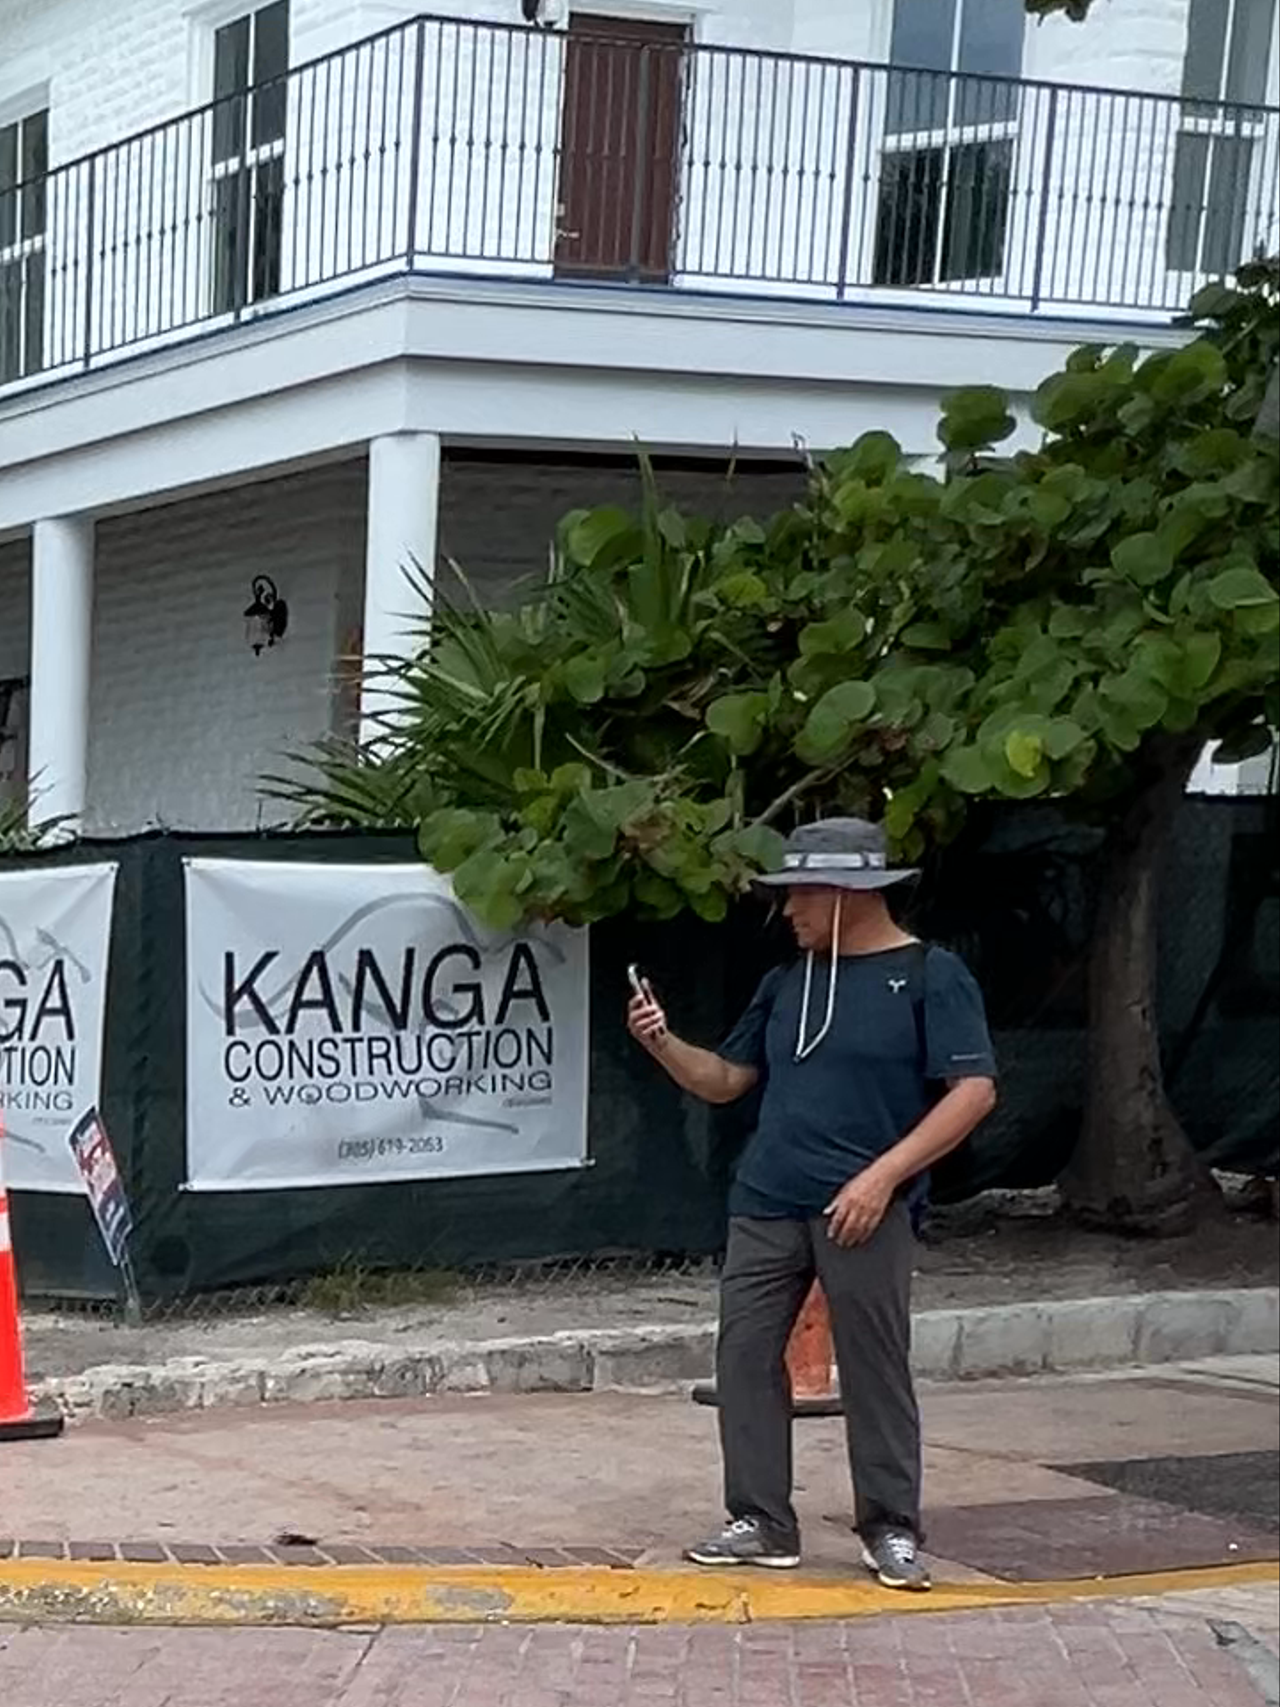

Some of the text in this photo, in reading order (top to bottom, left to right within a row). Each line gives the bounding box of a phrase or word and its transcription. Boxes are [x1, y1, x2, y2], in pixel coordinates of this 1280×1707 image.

[225, 942, 550, 1036] KANGA
[225, 1026, 553, 1083] CONSTRUCTION
[229, 1087, 251, 1107] &
[264, 1070, 552, 1105] WOODWORKING
